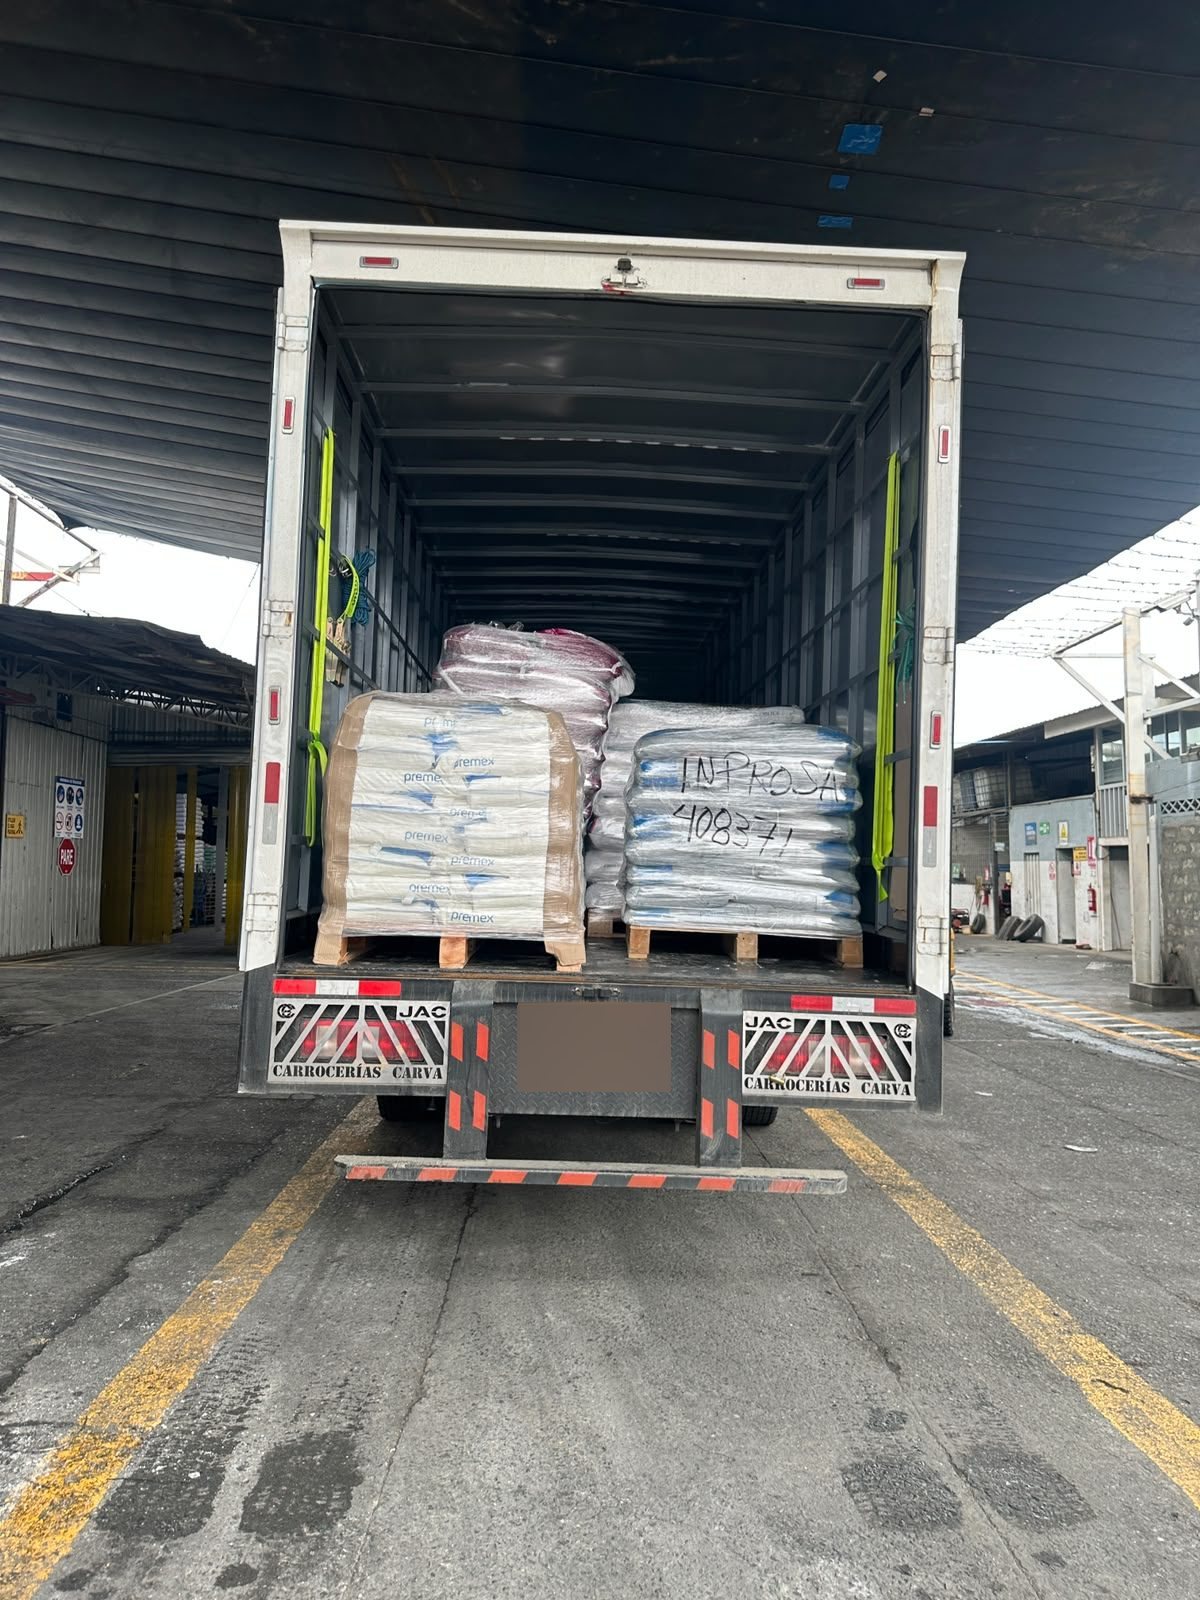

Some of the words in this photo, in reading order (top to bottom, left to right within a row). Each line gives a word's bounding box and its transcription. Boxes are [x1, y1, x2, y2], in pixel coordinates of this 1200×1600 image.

[404, 772, 442, 784] preme
[672, 803, 793, 857] 408371
[404, 831, 449, 843] premex
[60, 849, 74, 865] PARE
[451, 855, 495, 866] premex
[451, 911, 494, 923] premex
[399, 1006, 447, 1018] JAC
[745, 1016, 792, 1029] JAC
[272, 1063, 381, 1079] CARROCERÍAS
[392, 1066, 443, 1080] CARVA
[861, 1082, 911, 1096] CARVA
